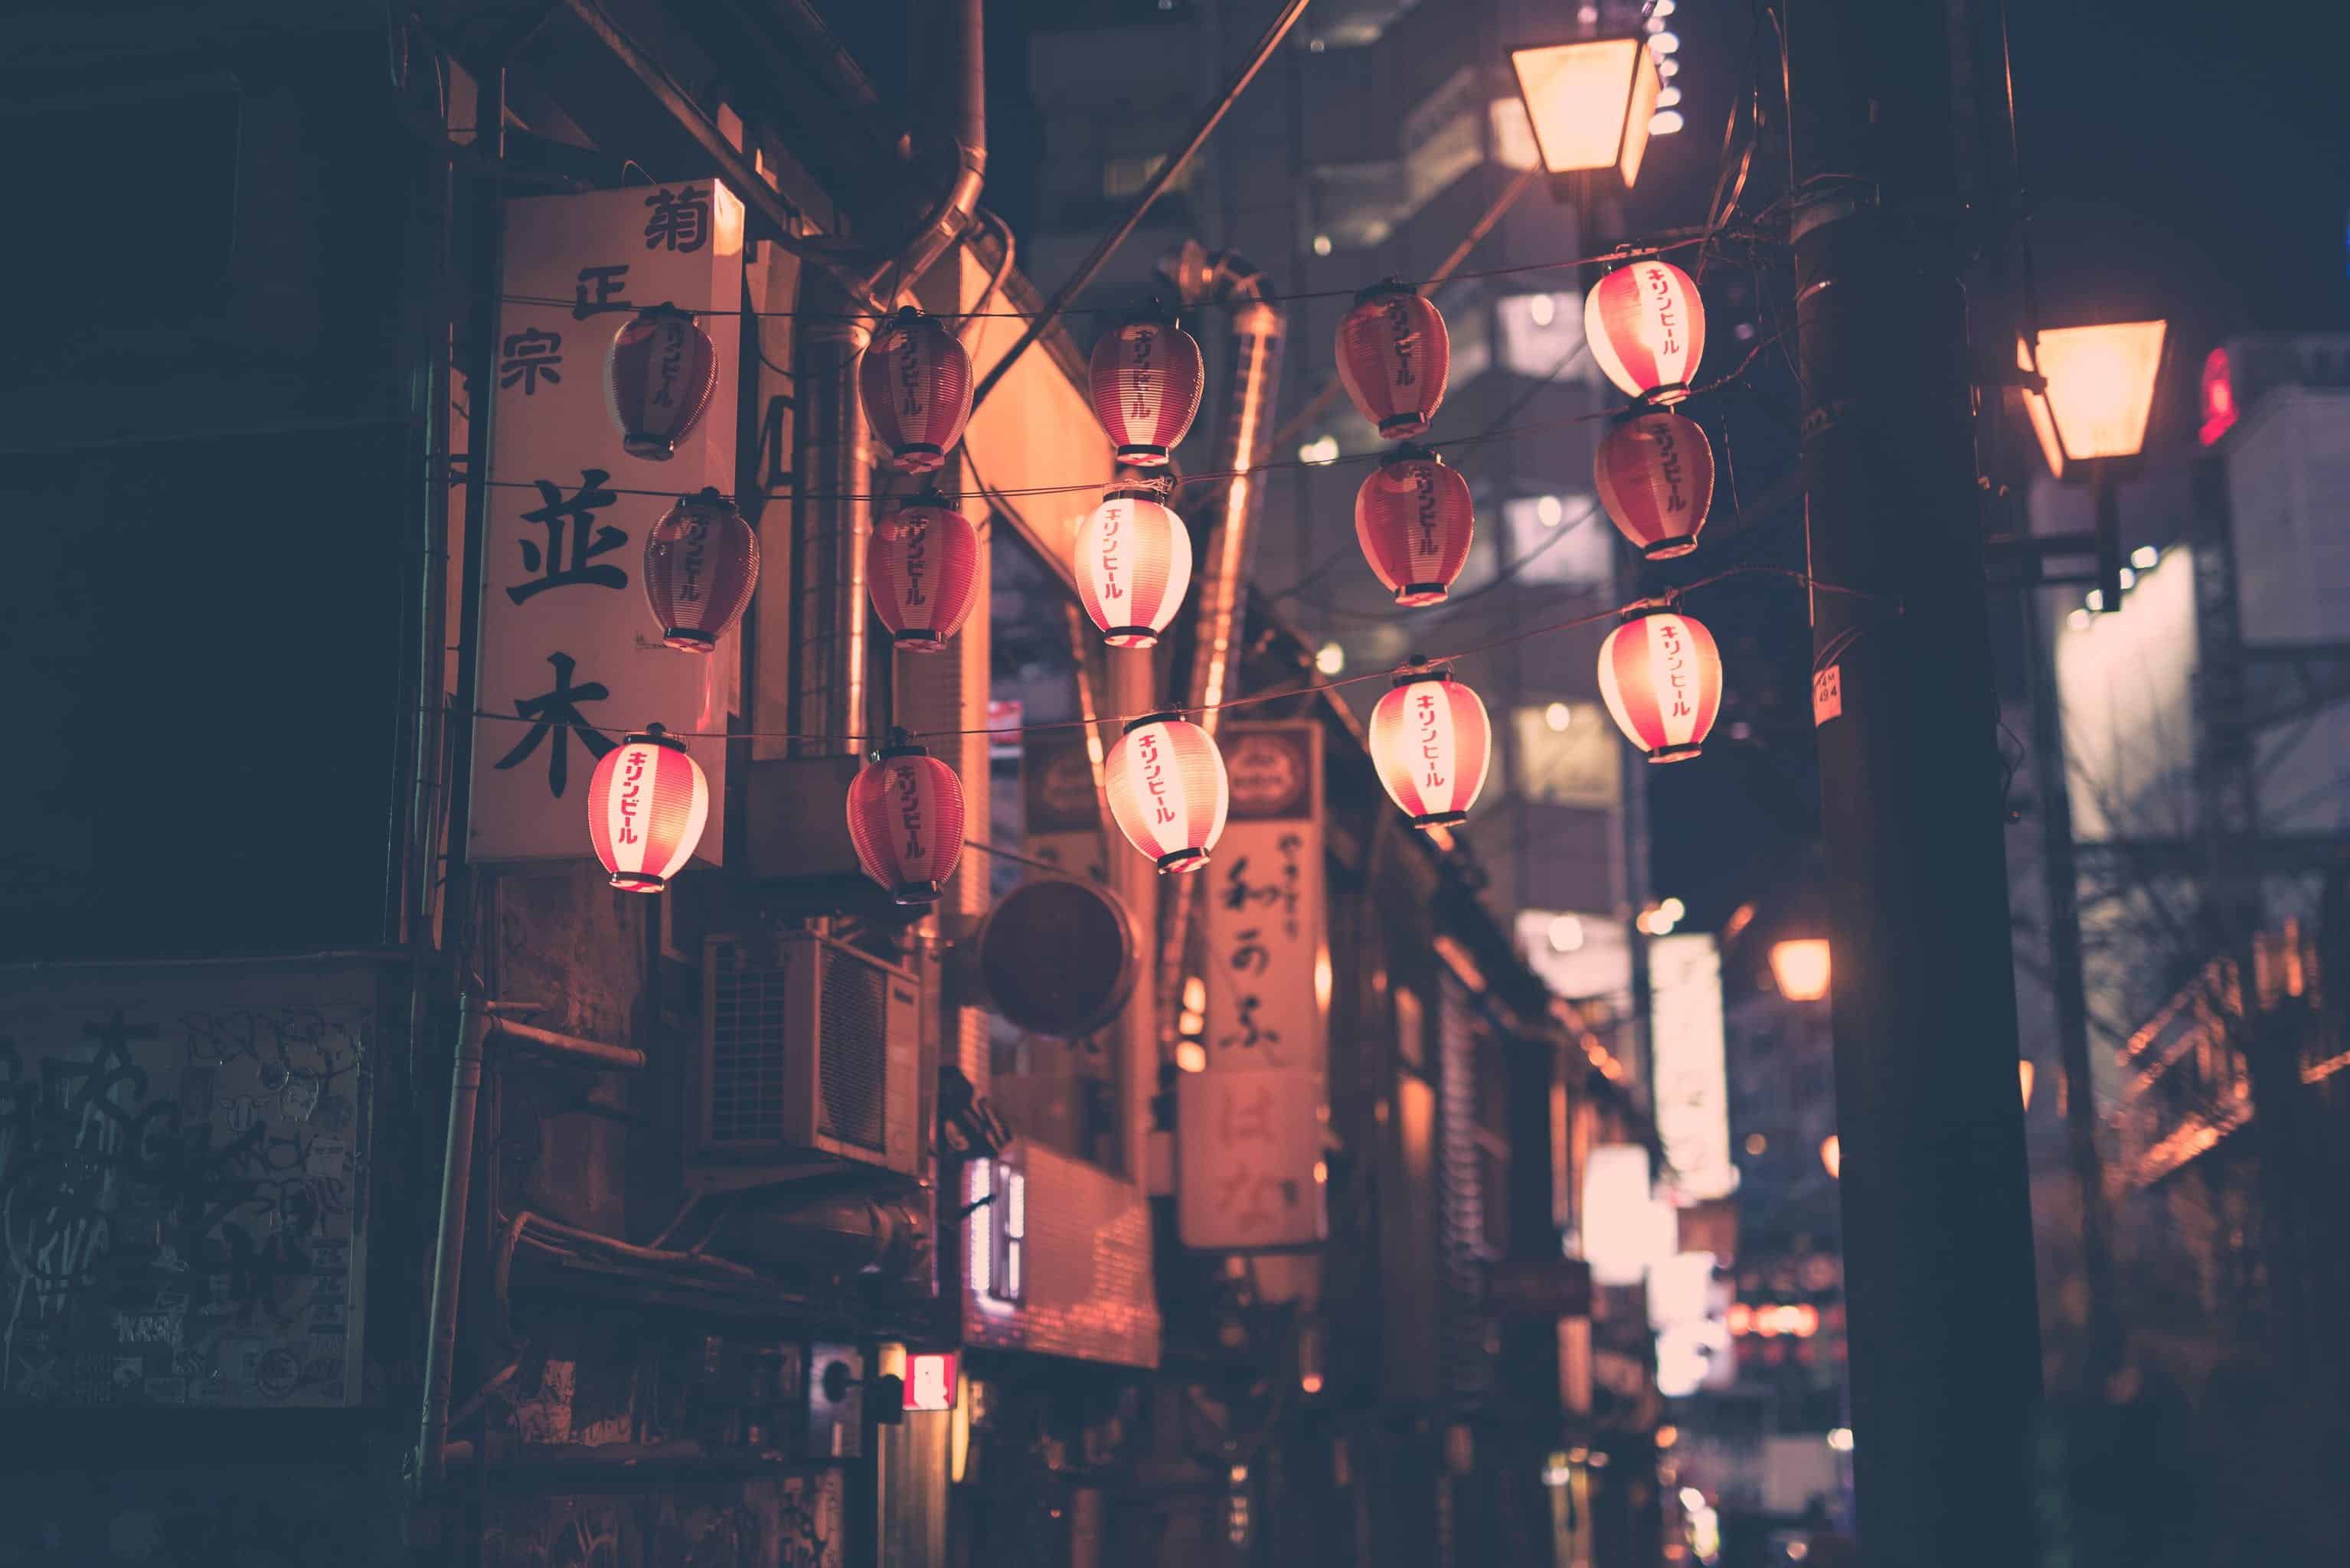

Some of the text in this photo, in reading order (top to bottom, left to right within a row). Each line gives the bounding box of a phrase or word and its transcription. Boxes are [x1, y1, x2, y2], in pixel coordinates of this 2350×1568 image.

[501, 185, 711, 396] 菊正宗
[1647, 269, 1679, 355] キリンビール
[906, 514, 931, 606] キリンビール
[492, 469, 629, 799] 並木
[1660, 626, 1690, 717] キリンビール
[1139, 734, 1175, 824] キリンビール
[1417, 695, 1444, 787] キリンビール
[619, 752, 647, 844] キリンビール
[895, 765, 926, 858] キリンビール
